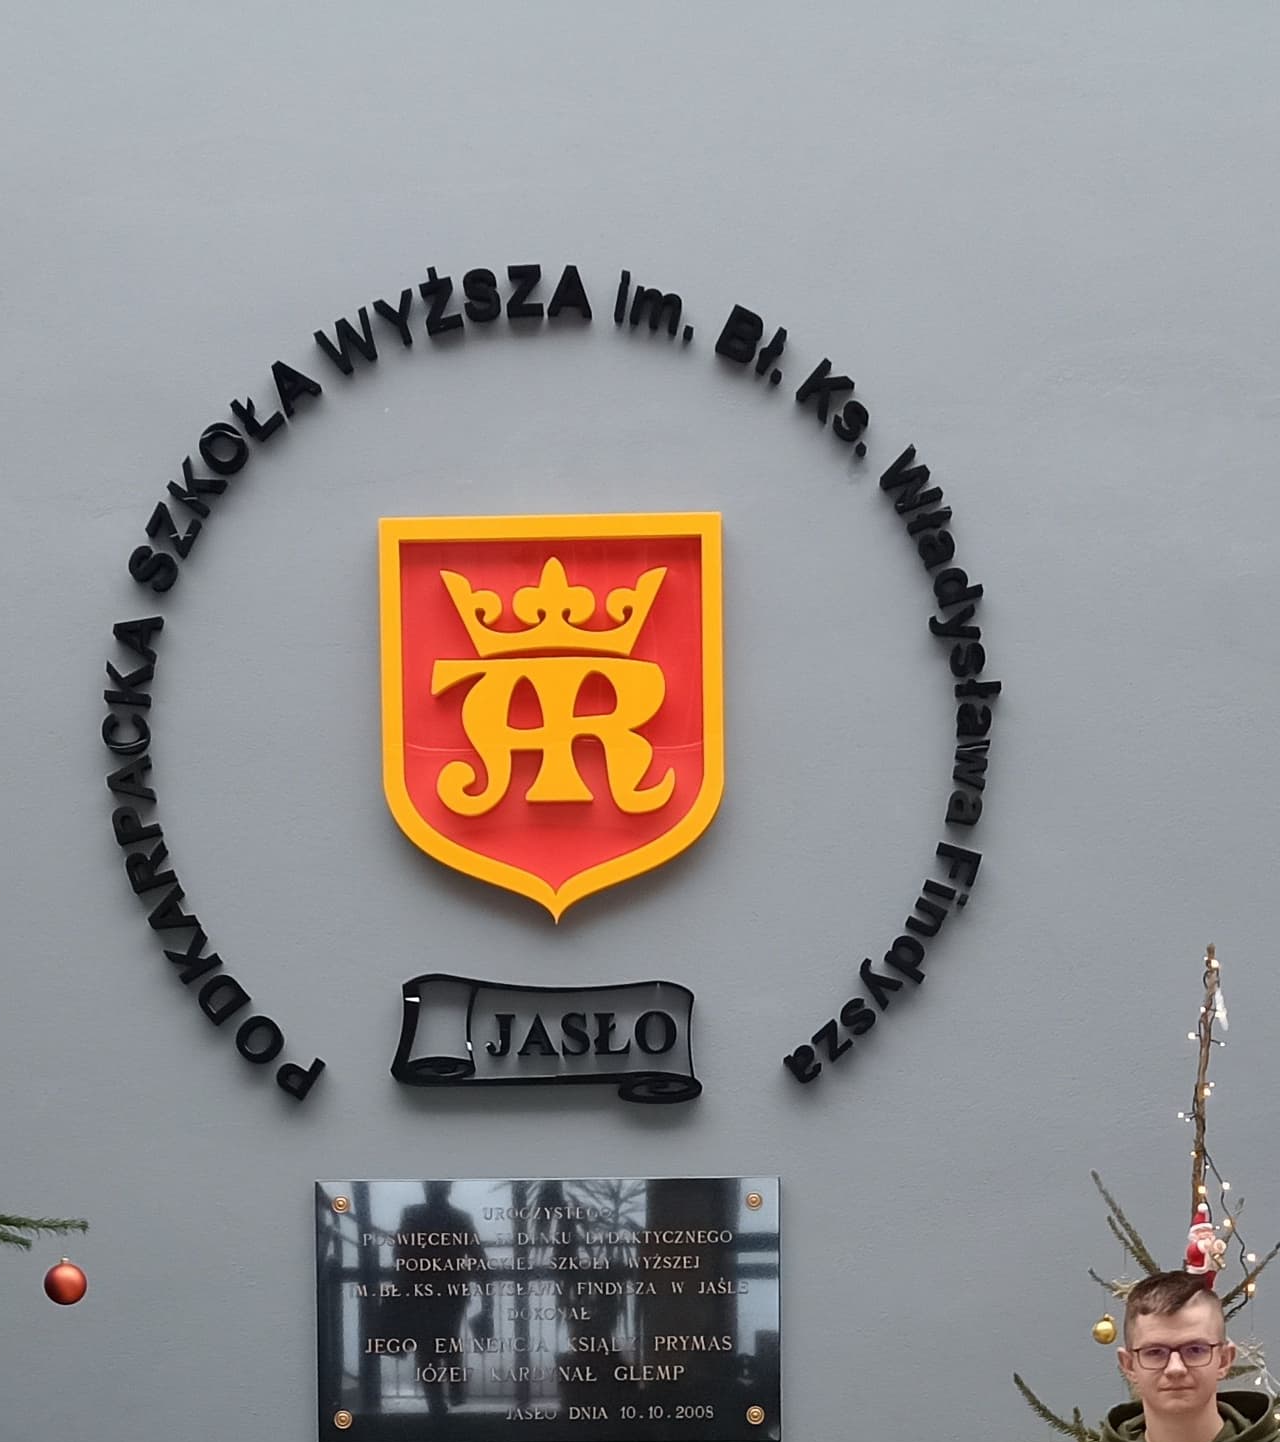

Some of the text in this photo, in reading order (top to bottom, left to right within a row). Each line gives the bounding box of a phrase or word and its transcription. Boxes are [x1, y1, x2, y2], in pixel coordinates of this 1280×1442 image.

[314, 264, 593, 375] WYŻSZA
[714, 303, 788, 385] Bł.
[795, 357, 872, 458] Ks.
[128, 360, 322, 594] SZKOŁA
[878, 442, 1002, 828] Władysława
[102, 616, 326, 1102] PODKARPACKA
[781, 841, 982, 1084] Findysza
[484, 1009, 678, 1060] JASŁO
[483, 1206, 613, 1221] UROCZYSTEGO
[586, 1230, 732, 1245] DYDAKTYCZNEGO
[396, 1253, 700, 1272] PODKARPACKIEJ SZKOŁY WYŻSZEJ
[447, 1281, 562, 1297] WŁADYSŁAWA
[577, 1281, 656, 1295] FINDYSZA
[672, 1281, 685, 1294] W
[698, 1276, 749, 1295] JAŚLE
[365, 1335, 733, 1356] JEGO EMINENCJA KSIĄDZ PRYMAS
[415, 1362, 685, 1383] JÓZEF KARDYNAŁ GLEMP
[505, 1406, 557, 1420] JASŁO
[569, 1406, 609, 1420] DNIA
